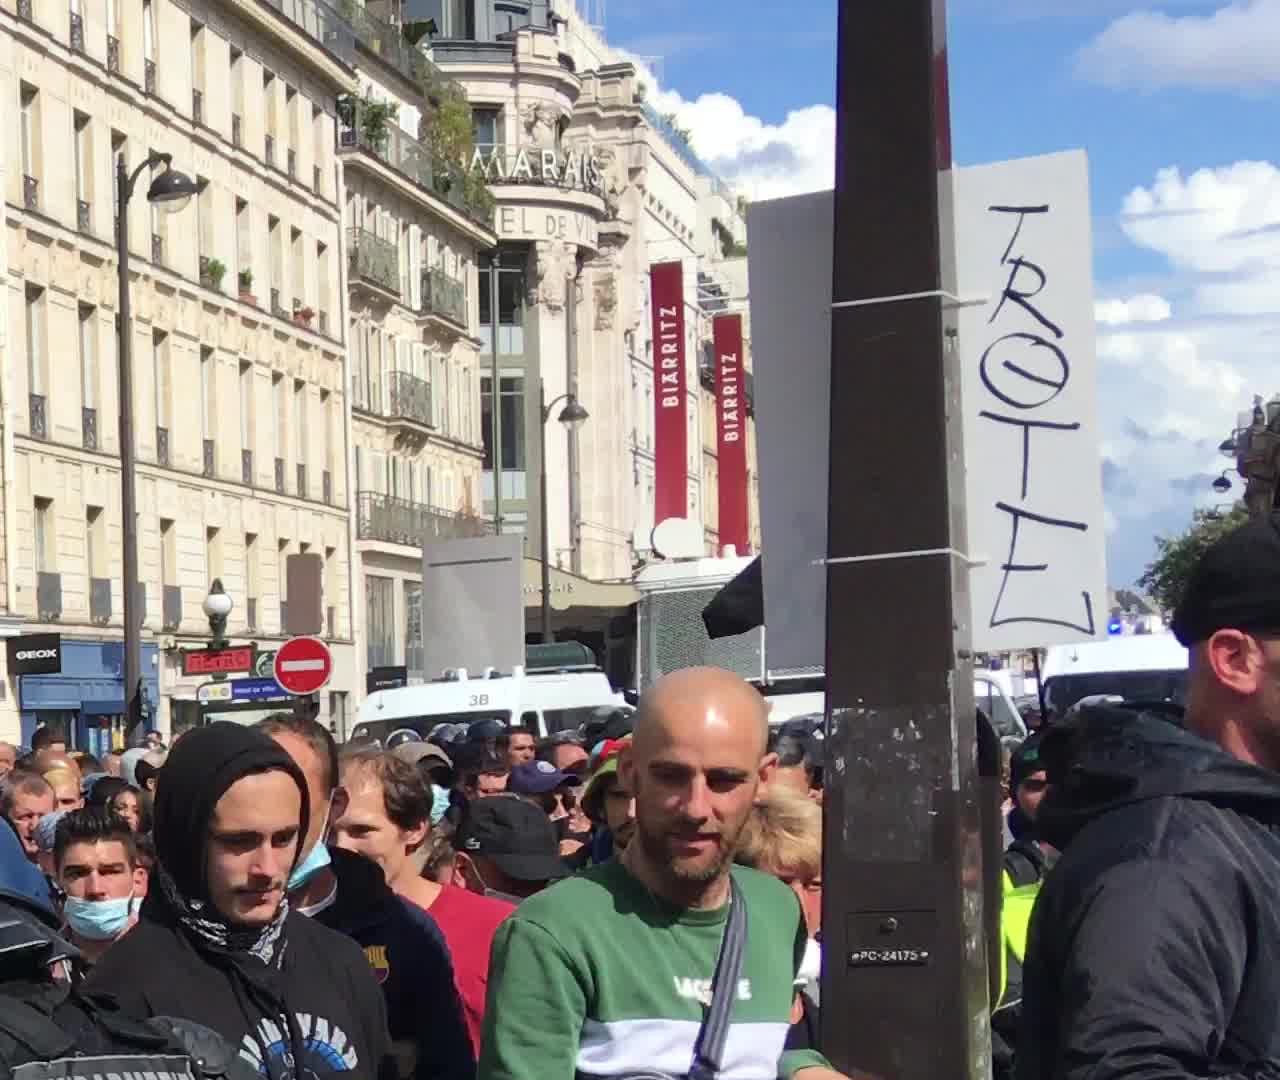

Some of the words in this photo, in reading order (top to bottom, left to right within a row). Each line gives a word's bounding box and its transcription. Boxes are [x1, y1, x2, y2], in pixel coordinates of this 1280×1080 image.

[470, 146, 601, 188] MARAIS
[15, 648, 57, 660] GEOX
[468, 693, 490, 707] 3B
